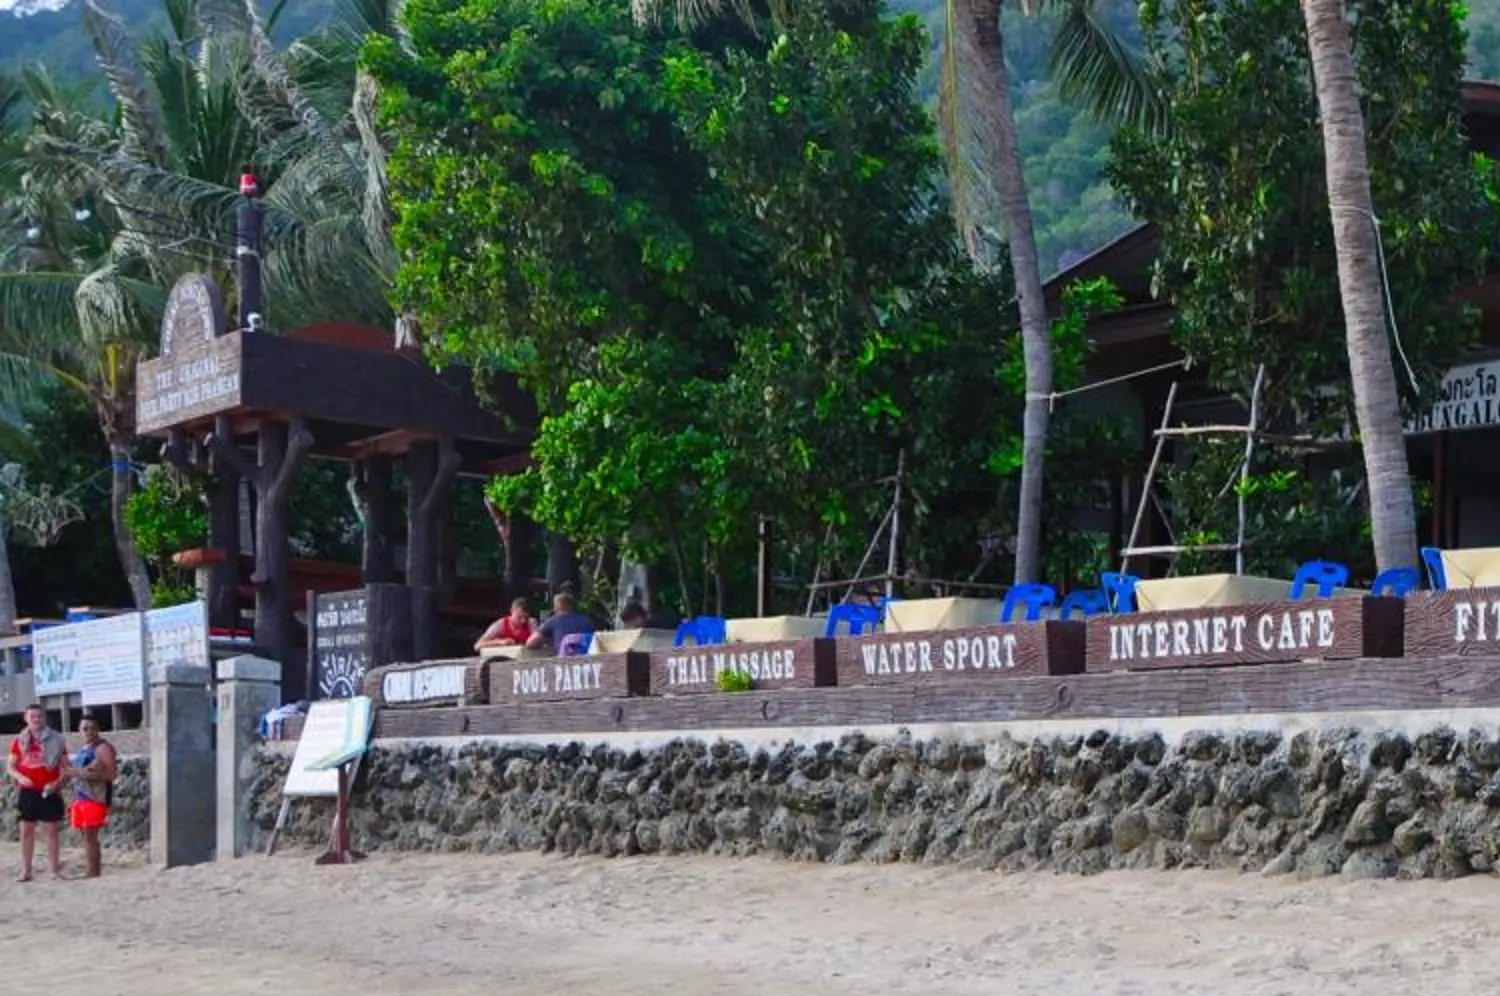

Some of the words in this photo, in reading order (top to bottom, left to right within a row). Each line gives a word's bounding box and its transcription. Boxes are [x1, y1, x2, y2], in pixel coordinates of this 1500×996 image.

[861, 640, 934, 675] WATER
[943, 633, 1017, 671] SPORT
[1109, 614, 1247, 661] INTERNET
[1257, 608, 1335, 651] CAFE
[512, 667, 549, 695] POOL
[554, 663, 602, 692] PARTY
[666, 654, 707, 685] THAI
[712, 649, 795, 682] MASSAGE
